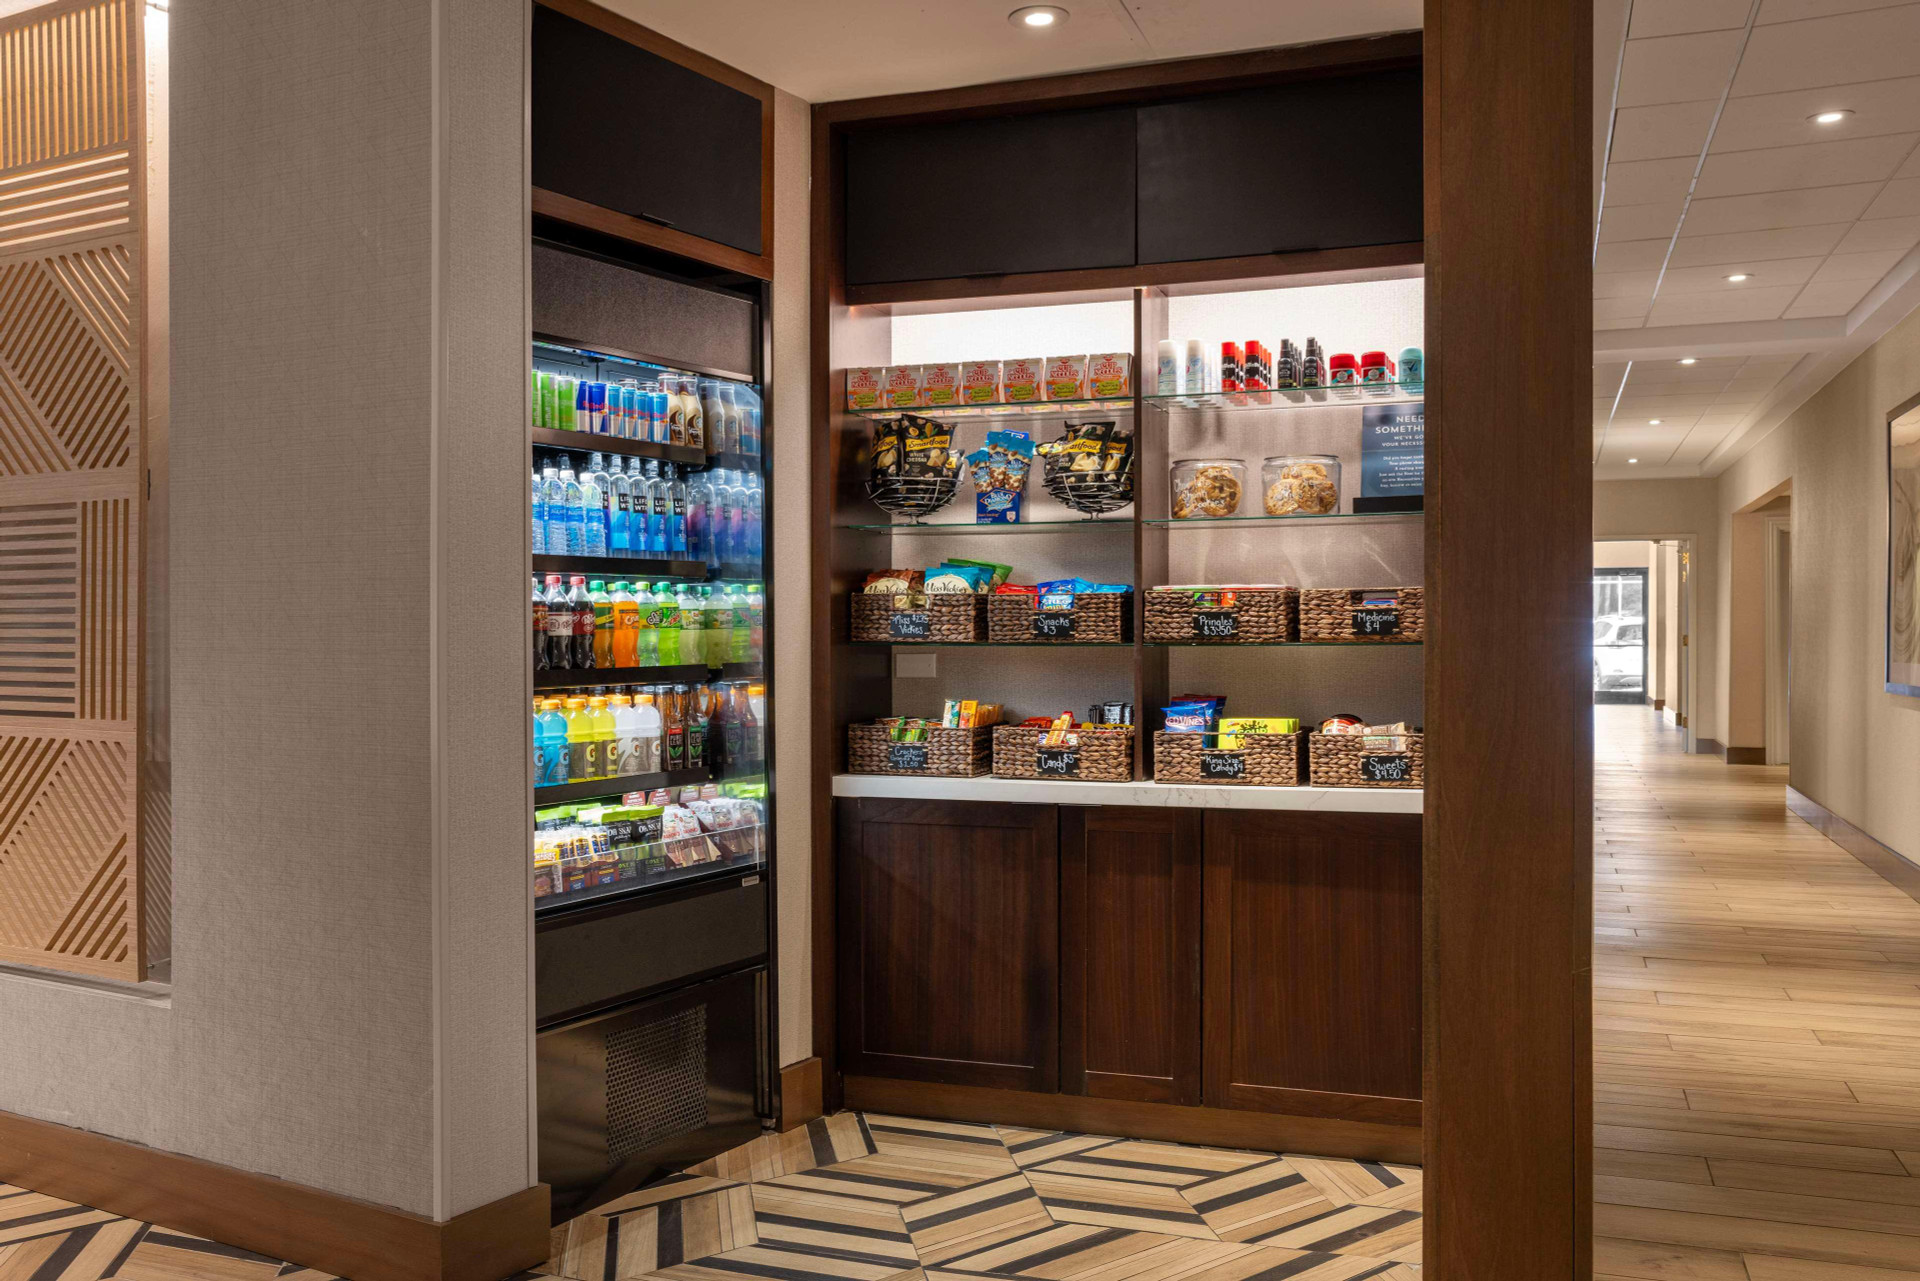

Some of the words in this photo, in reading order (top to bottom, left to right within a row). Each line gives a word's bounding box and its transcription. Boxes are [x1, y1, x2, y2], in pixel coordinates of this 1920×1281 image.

[1375, 425, 1424, 434] SOMETHI
[909, 437, 949, 448] Smartfood
[892, 614, 911, 625] Miss
[1038, 614, 1070, 627] Snacks
[1358, 611, 1396, 622] Medicine
[1198, 615, 1233, 630] Pringles
[1365, 620, 1380, 633] $4
[1043, 625, 1056, 635] $3
[1203, 625, 1232, 636] $3.50
[1041, 755, 1066, 773] Candy
[1064, 753, 1075, 764] $3
[1205, 755, 1223, 766] King
[1223, 754, 1240, 764] Size
[1369, 757, 1407, 771] Sweets
[1210, 763, 1234, 775] Candy
[1374, 770, 1402, 780] $4.50
